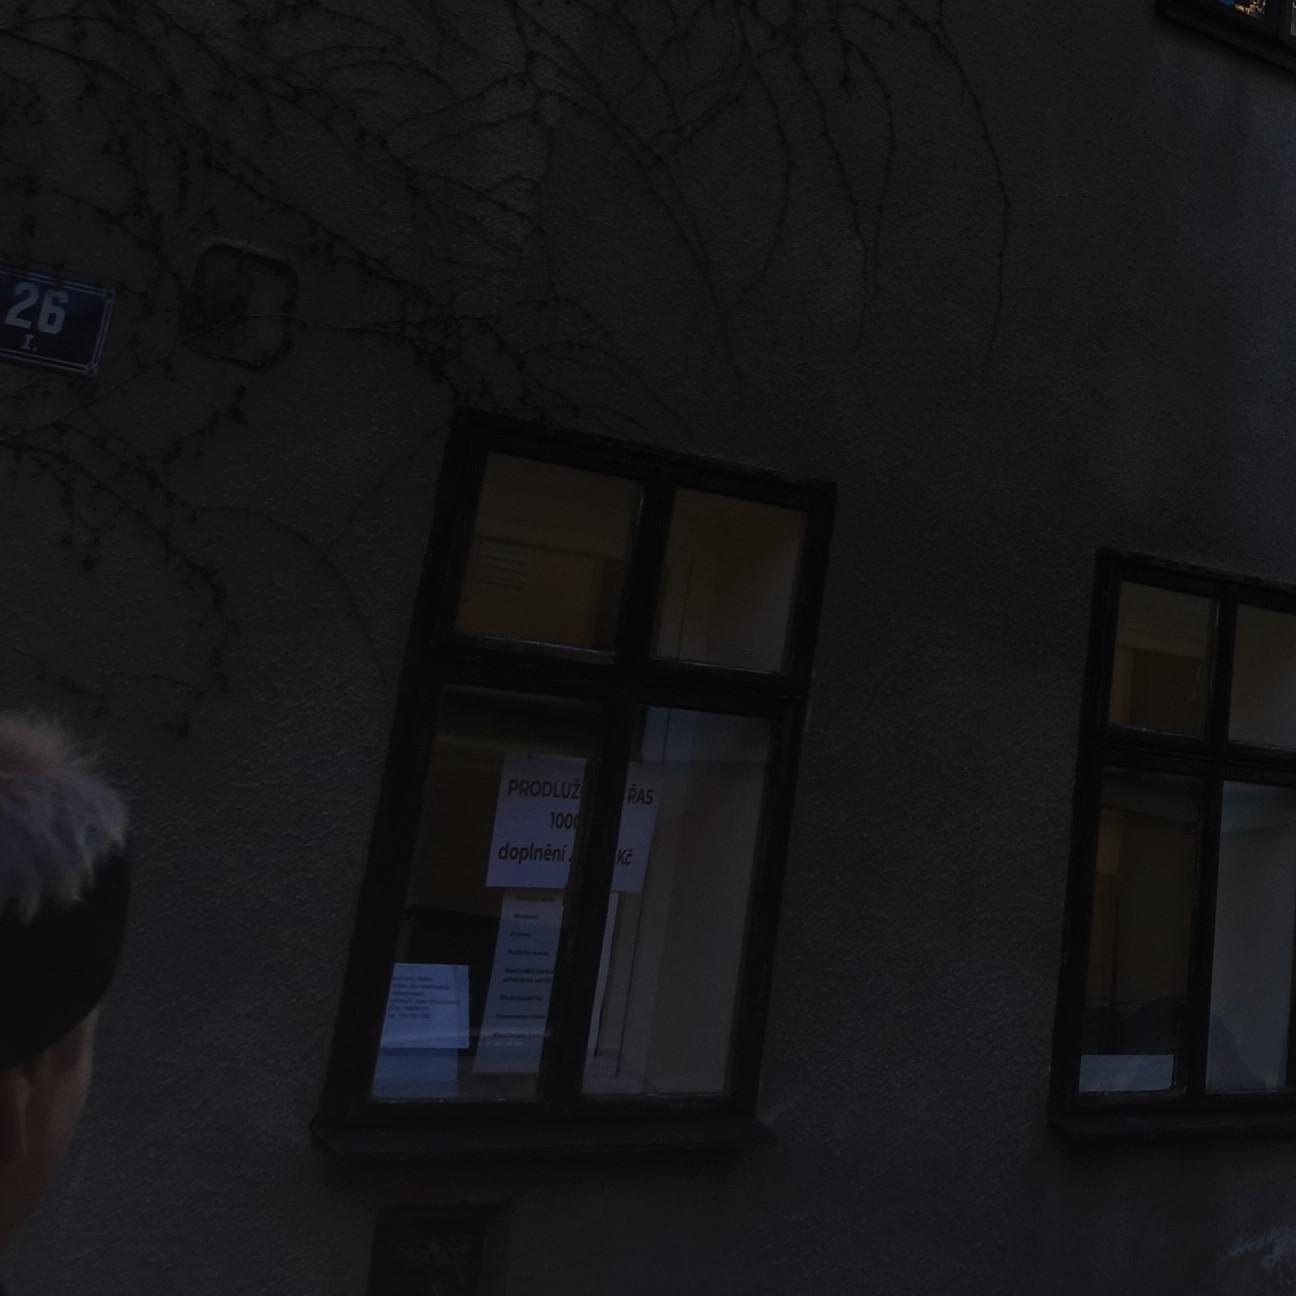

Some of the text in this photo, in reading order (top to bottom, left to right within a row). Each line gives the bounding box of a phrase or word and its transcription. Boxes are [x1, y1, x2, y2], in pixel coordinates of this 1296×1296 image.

[6, 281, 70, 335] 26
[507, 778, 654, 805] PRODLUŽ ŘAS
[498, 841, 568, 865] doplnění
